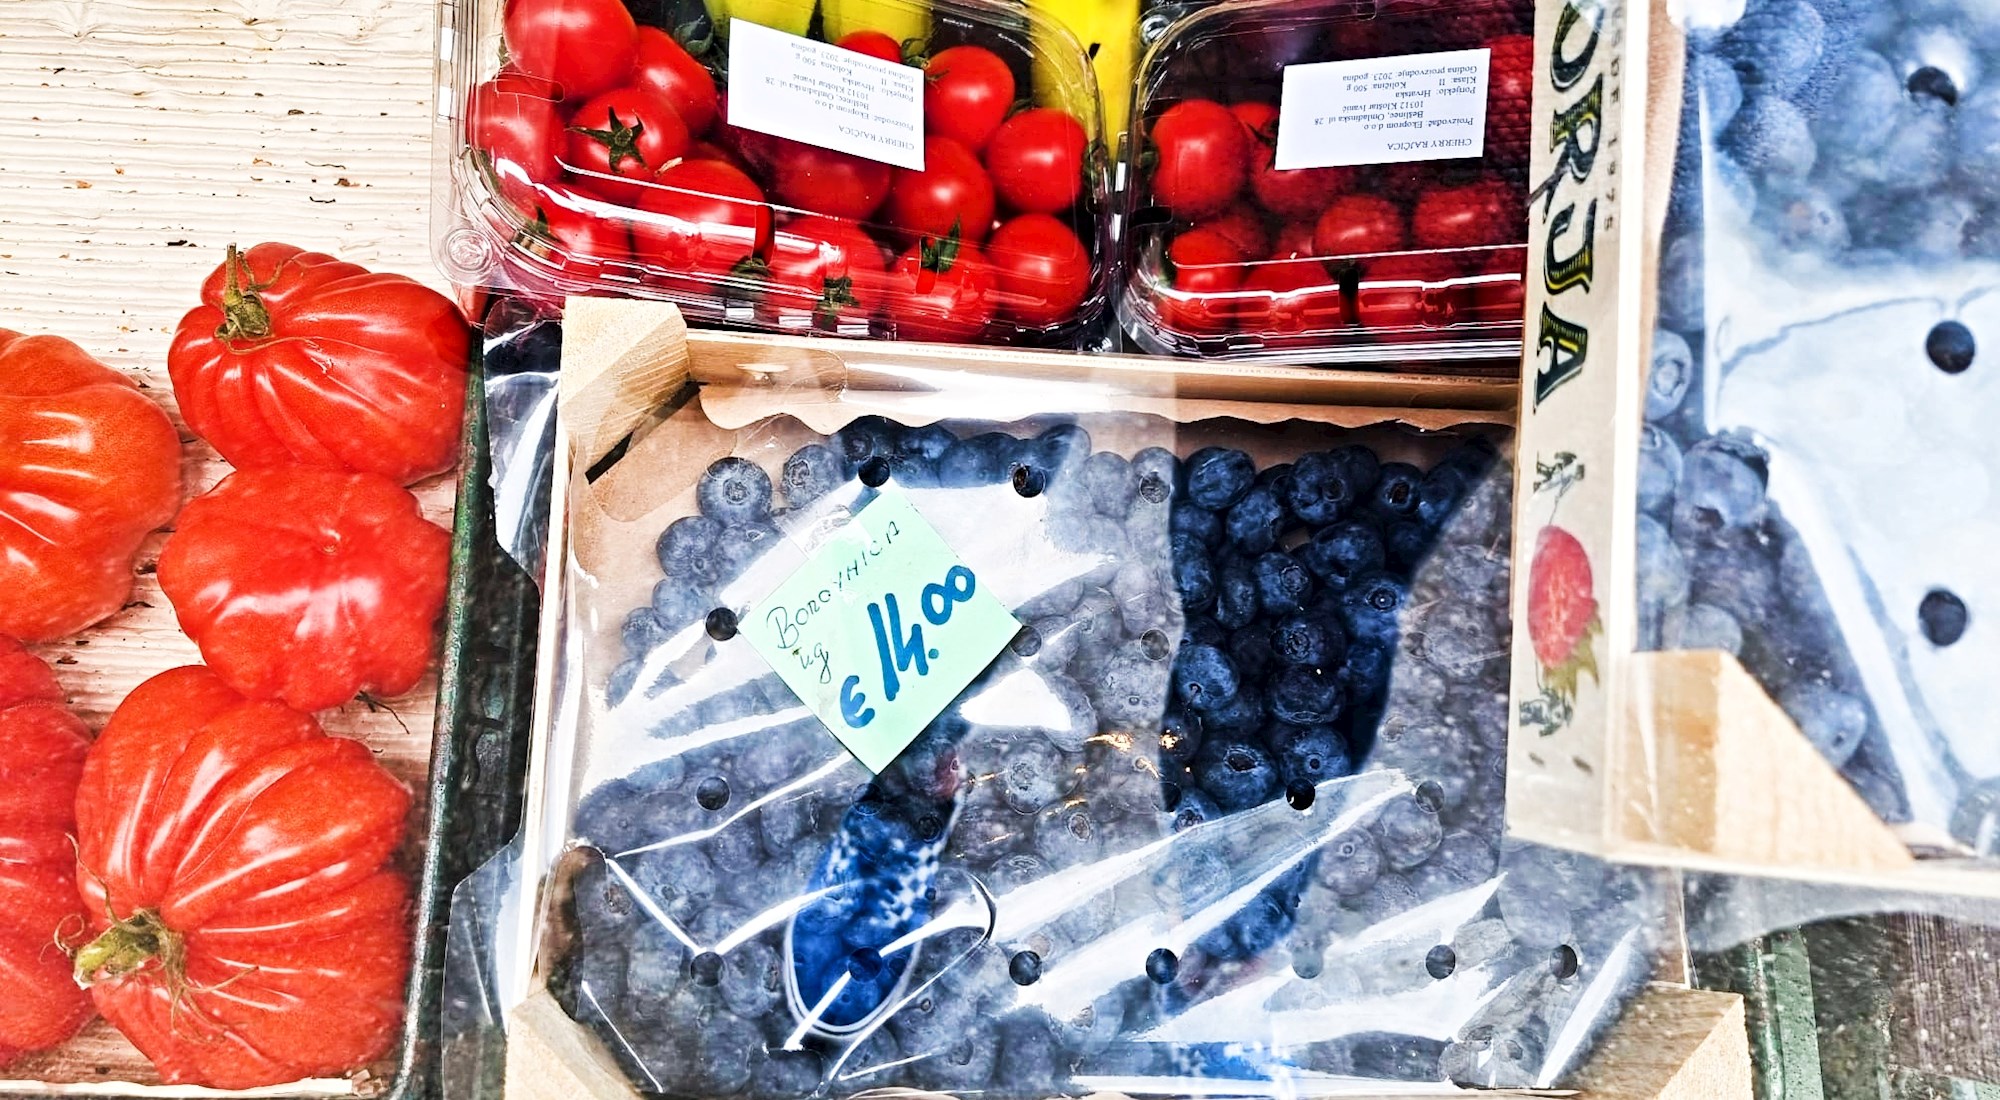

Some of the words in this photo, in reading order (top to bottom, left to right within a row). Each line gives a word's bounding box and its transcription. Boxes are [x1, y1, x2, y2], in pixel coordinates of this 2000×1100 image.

[1448, 66, 1477, 75] Godina
[1342, 73, 1368, 82] godina
[1353, 84, 1368, 92] 500
[1395, 90, 1431, 99] Hrvatska
[1342, 104, 1366, 113] Ivanić
[1368, 102, 1397, 110] Kloštar
[1400, 101, 1424, 110] 10312
[1338, 114, 1385, 123] Omladinska
[1388, 111, 1424, 119] Bešlinec,
[1386, 121, 1422, 129] Ekoprom
[1387, 141, 1428, 150] RAJČICA
[1431, 139, 1472, 148] CHERRY
[1604, 132, 1618, 231] 1975
[867, 565, 976, 701] 14.00
